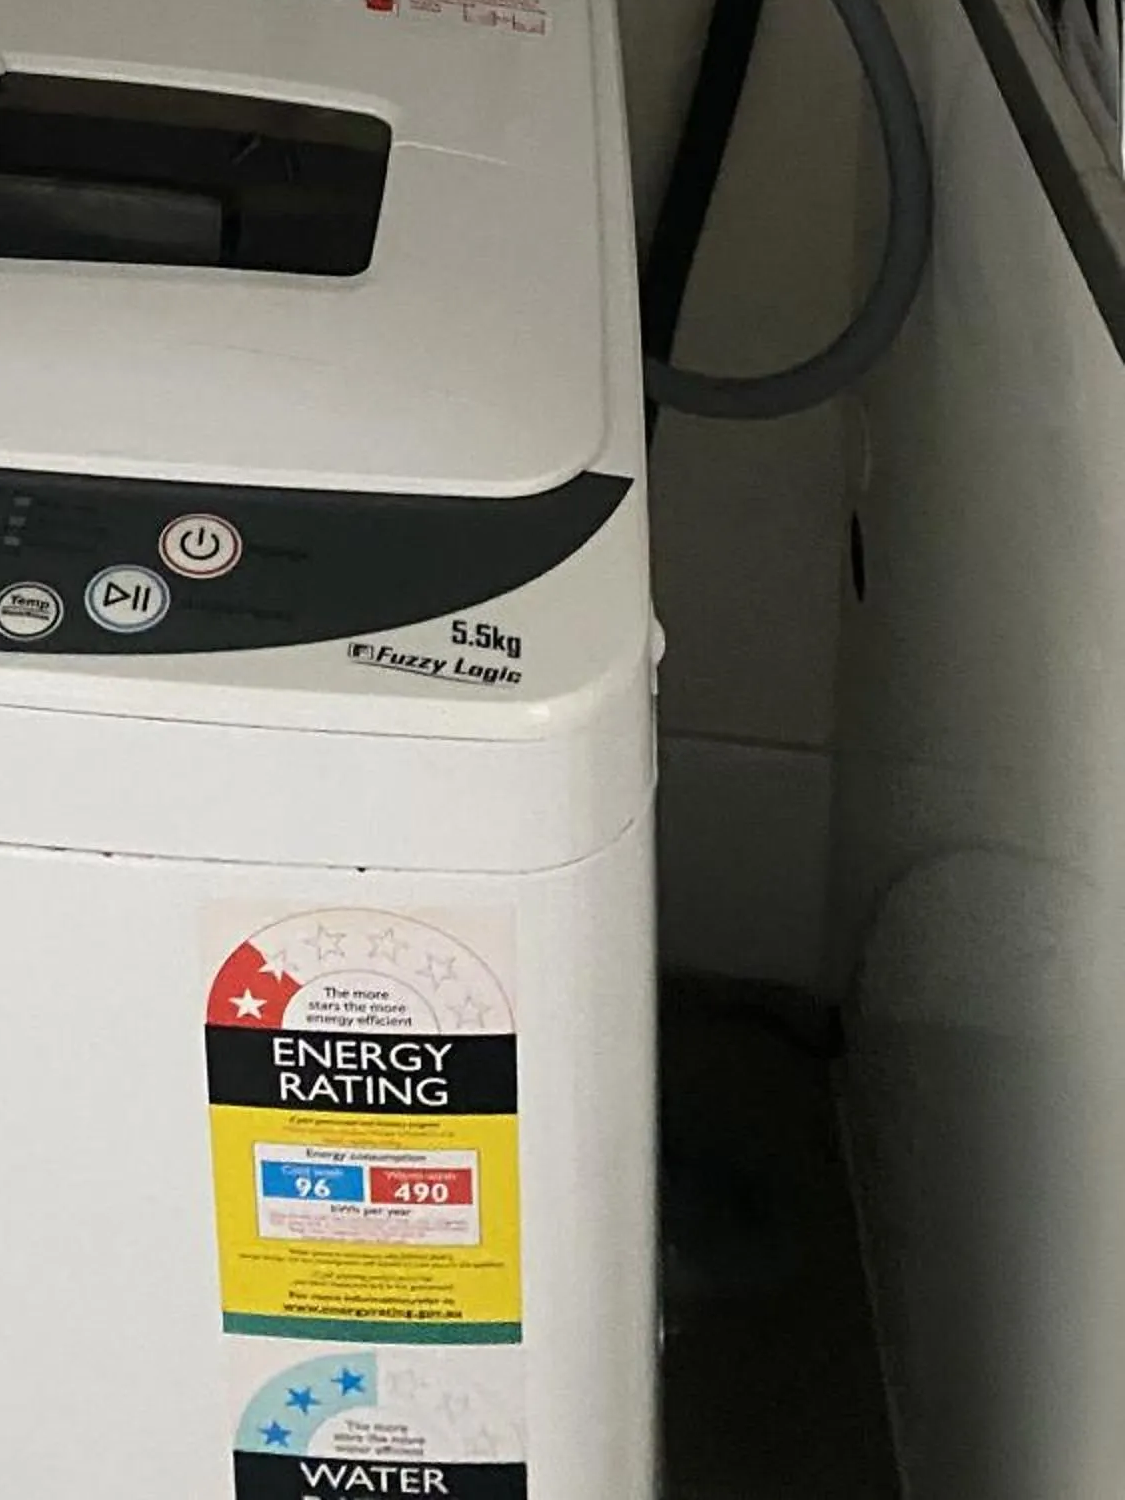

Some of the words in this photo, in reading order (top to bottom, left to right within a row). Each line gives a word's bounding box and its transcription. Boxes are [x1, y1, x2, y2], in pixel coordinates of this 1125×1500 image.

[11, 594, 50, 611] Temp
[451, 619, 522, 660] 5.5kg
[376, 645, 448, 675] Fuzzy
[454, 657, 523, 683] Logic
[323, 986, 350, 998] The
[353, 990, 390, 1000] more
[308, 1000, 341, 1011] stars
[344, 1001, 367, 1012] the
[370, 1003, 407, 1013] more
[306, 1014, 354, 1026] energy
[356, 1015, 412, 1027] efficient
[273, 1037, 453, 1073] ENERGY
[280, 1071, 448, 1106] RATING
[295, 1177, 331, 1197] 96
[394, 1182, 449, 1203] 490
[300, 1461, 449, 1494] WATER
